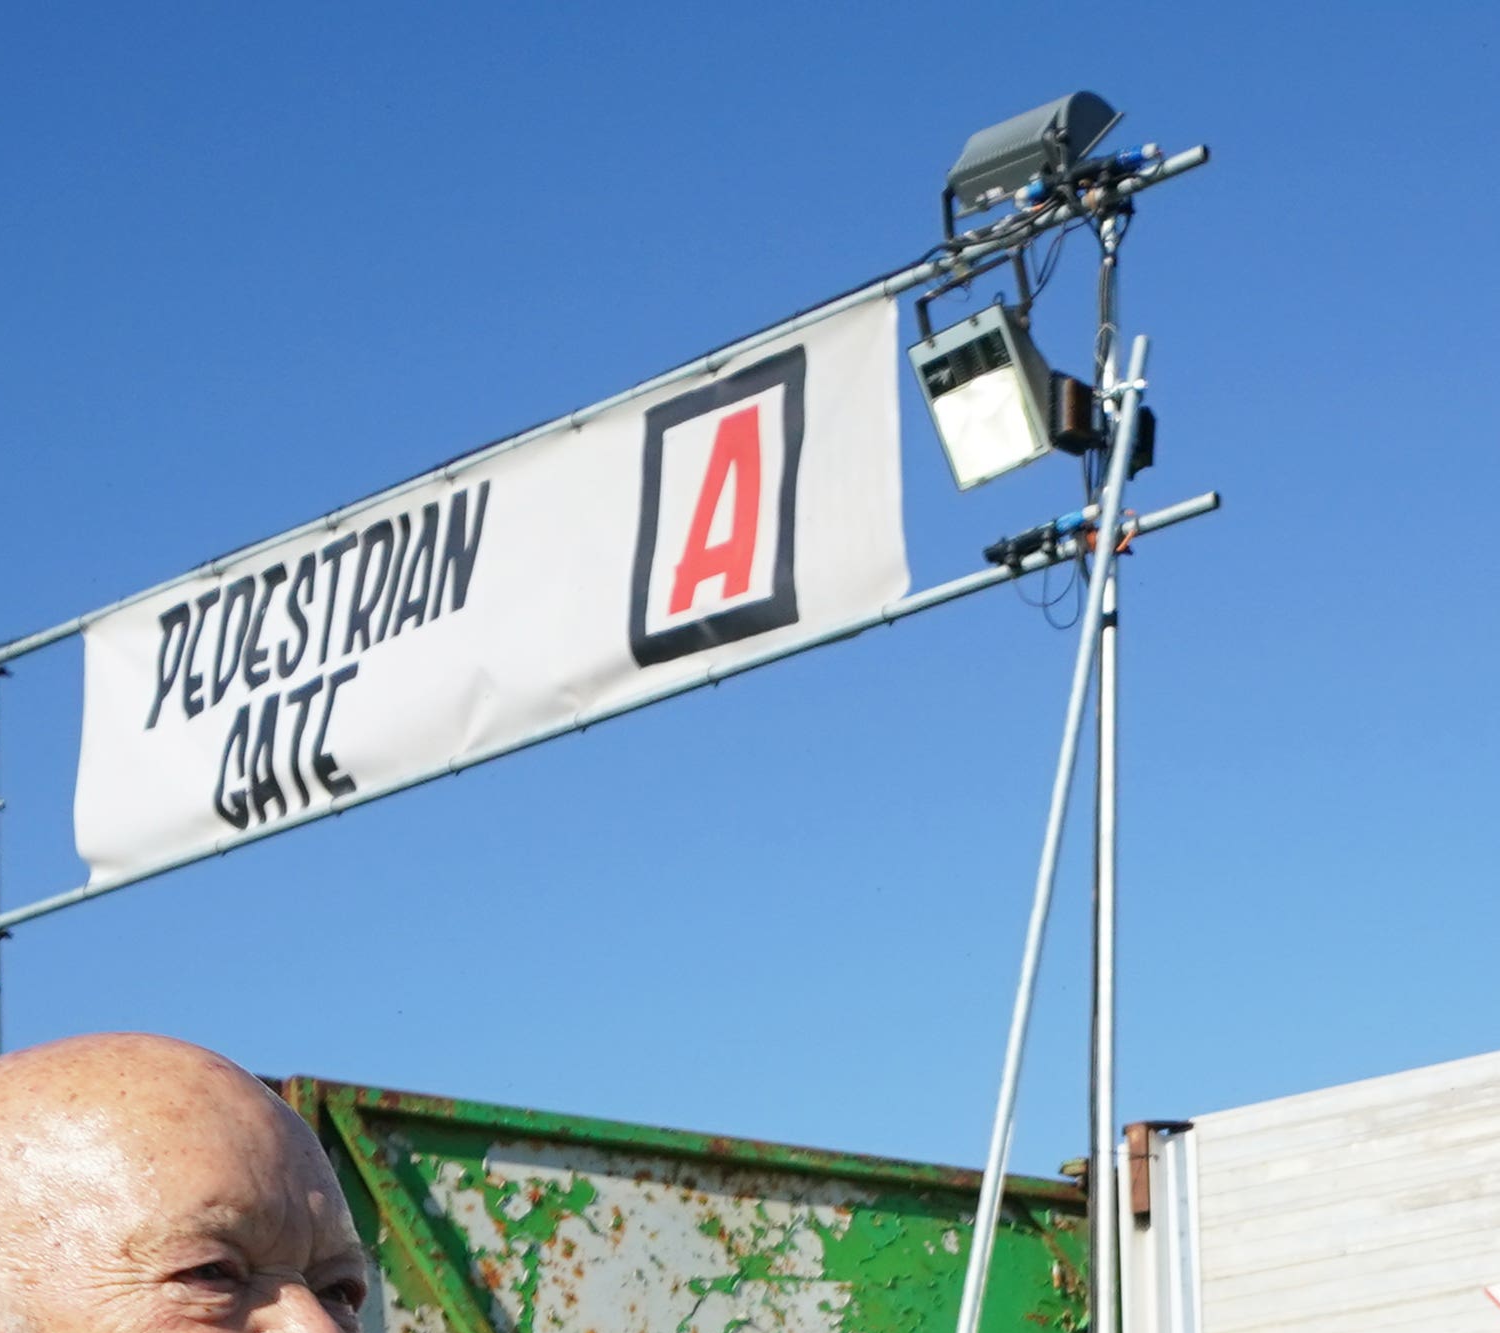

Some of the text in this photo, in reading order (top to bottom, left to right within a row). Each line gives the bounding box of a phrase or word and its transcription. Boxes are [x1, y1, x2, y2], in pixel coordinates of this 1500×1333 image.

[145, 480, 490, 730] PEDESTRIAN
[668, 405, 761, 616] A
[214, 664, 358, 830] GATE
